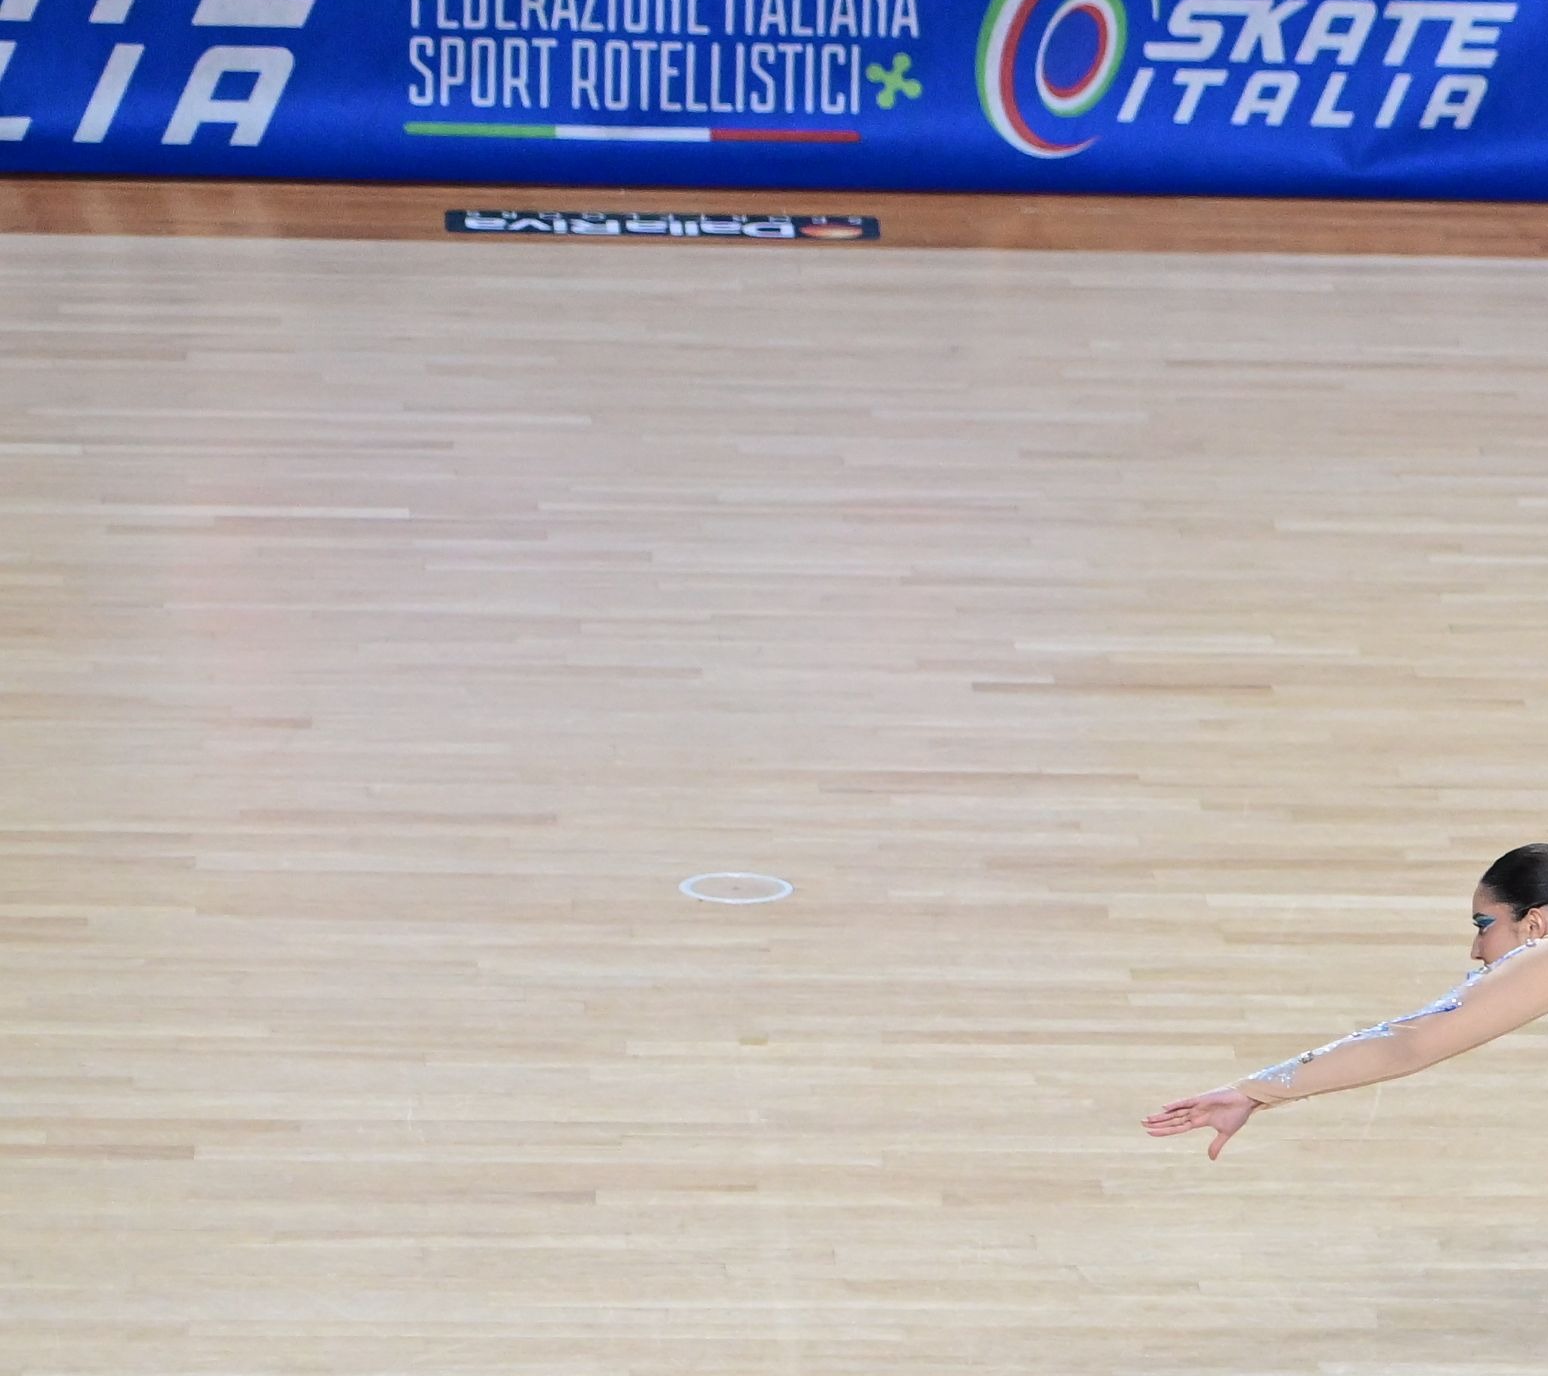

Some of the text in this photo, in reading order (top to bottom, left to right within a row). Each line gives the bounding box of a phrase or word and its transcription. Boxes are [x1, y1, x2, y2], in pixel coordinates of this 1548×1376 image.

[408, 36, 861, 115] SPORT ROTELLISTICI
[1116, 66, 1489, 130] ITALIA
